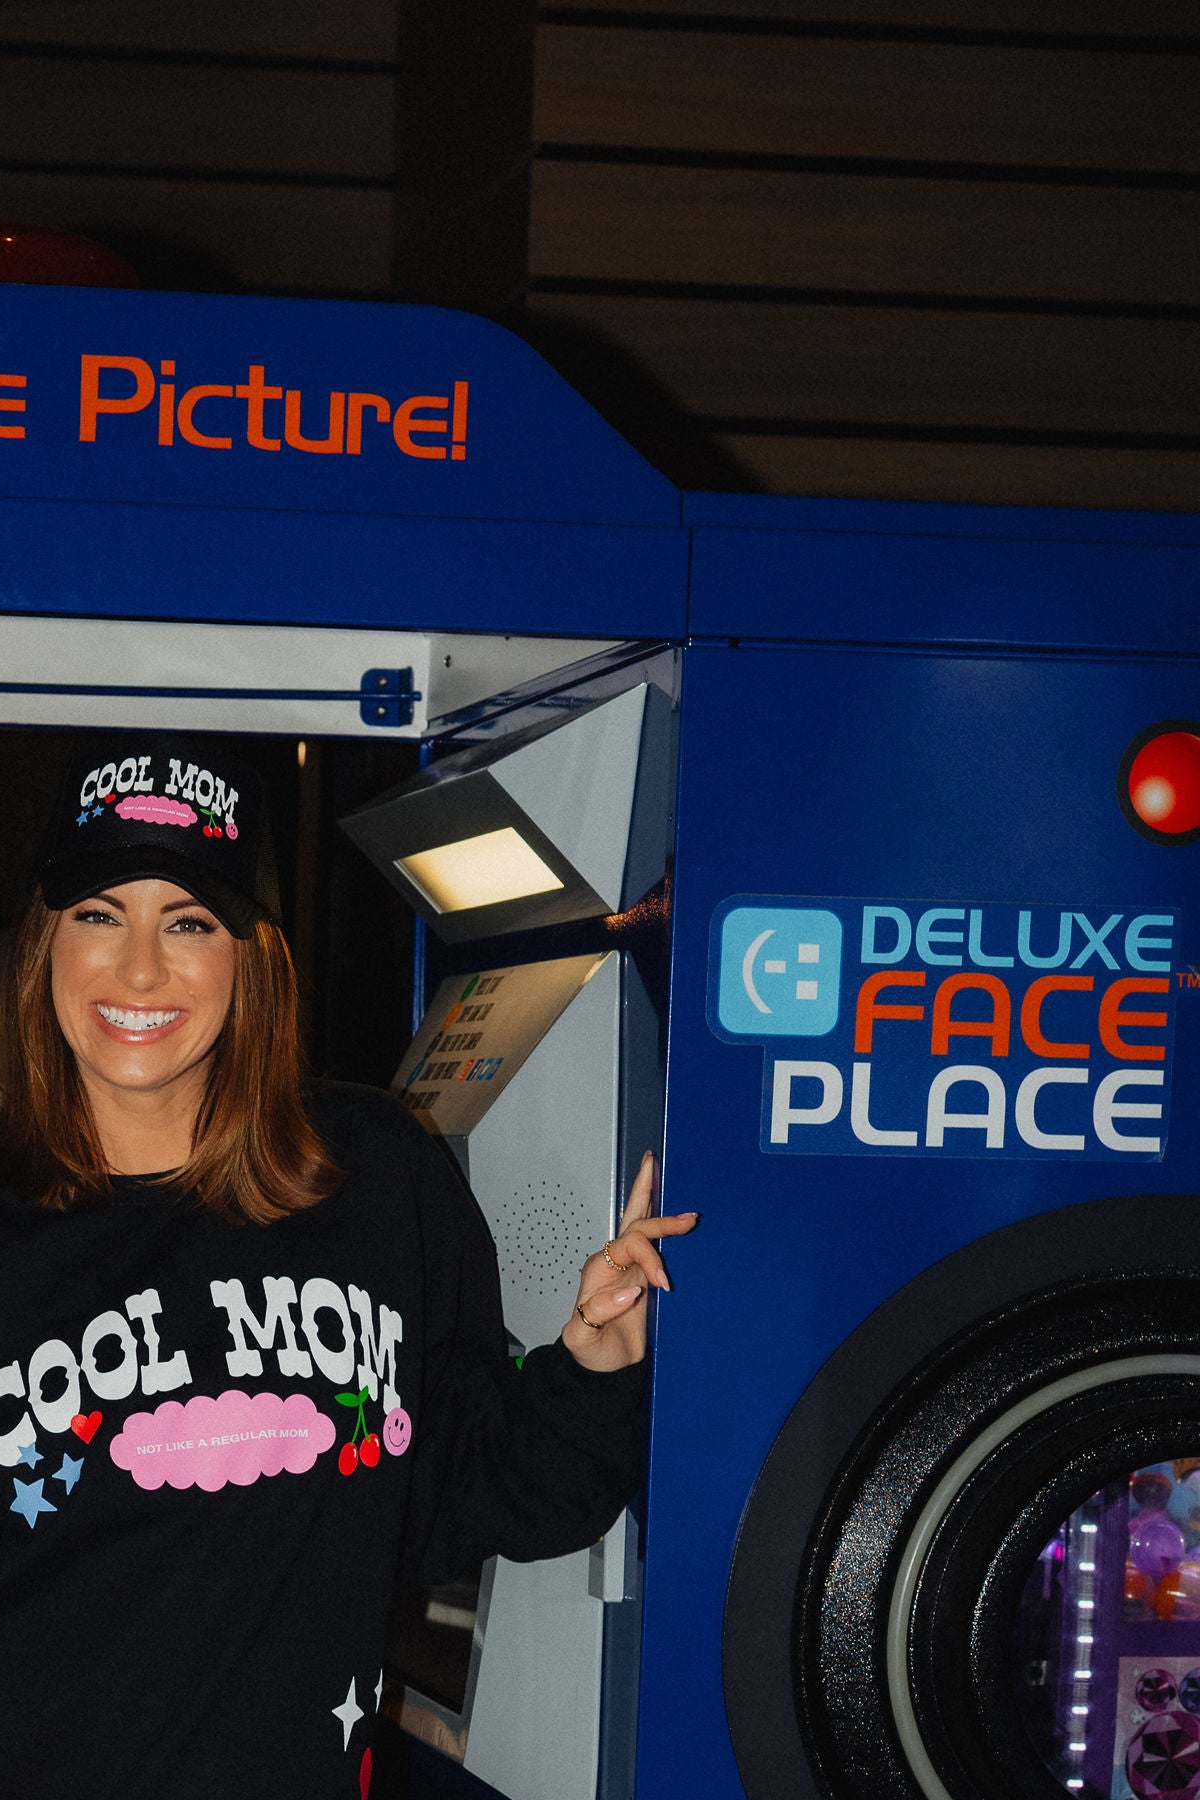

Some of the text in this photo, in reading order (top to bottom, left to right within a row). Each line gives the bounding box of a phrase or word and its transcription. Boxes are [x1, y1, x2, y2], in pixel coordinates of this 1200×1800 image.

[79, 354, 469, 461] Picture!
[80, 755, 239, 824] COOL MOM
[860, 905, 1174, 972] DELUXE
[854, 970, 1170, 1061] FACE
[770, 1060, 1165, 1153] PLACE
[210, 1275, 404, 1414] MOM
[136, 1429, 310, 1456] NOT LIKE A REGULAR MOM
